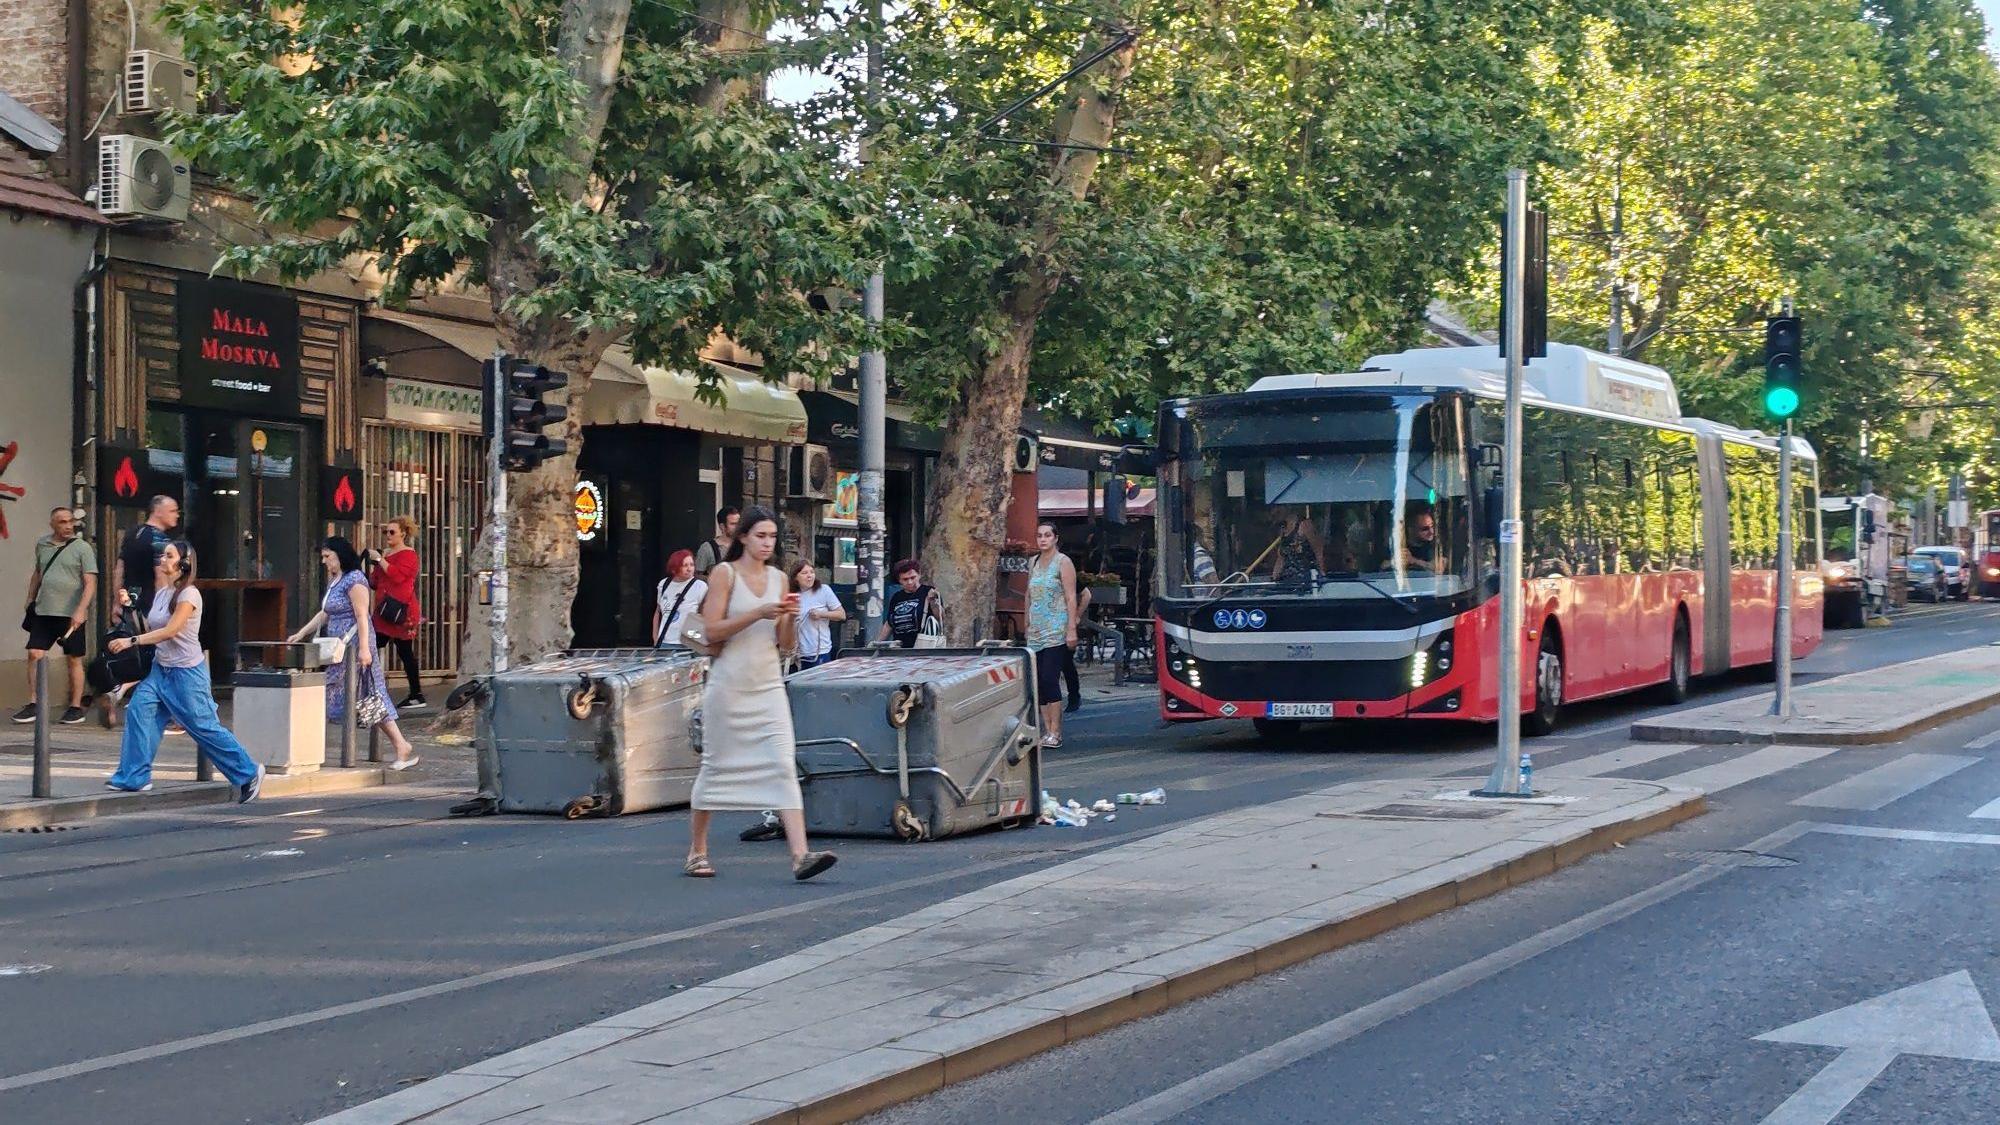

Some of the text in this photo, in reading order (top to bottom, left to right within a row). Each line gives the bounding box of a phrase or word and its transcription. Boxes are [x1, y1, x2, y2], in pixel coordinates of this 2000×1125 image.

[235, 380, 252, 390] food
[258, 383, 271, 392] bar
[1274, 704, 1286, 716] BG
